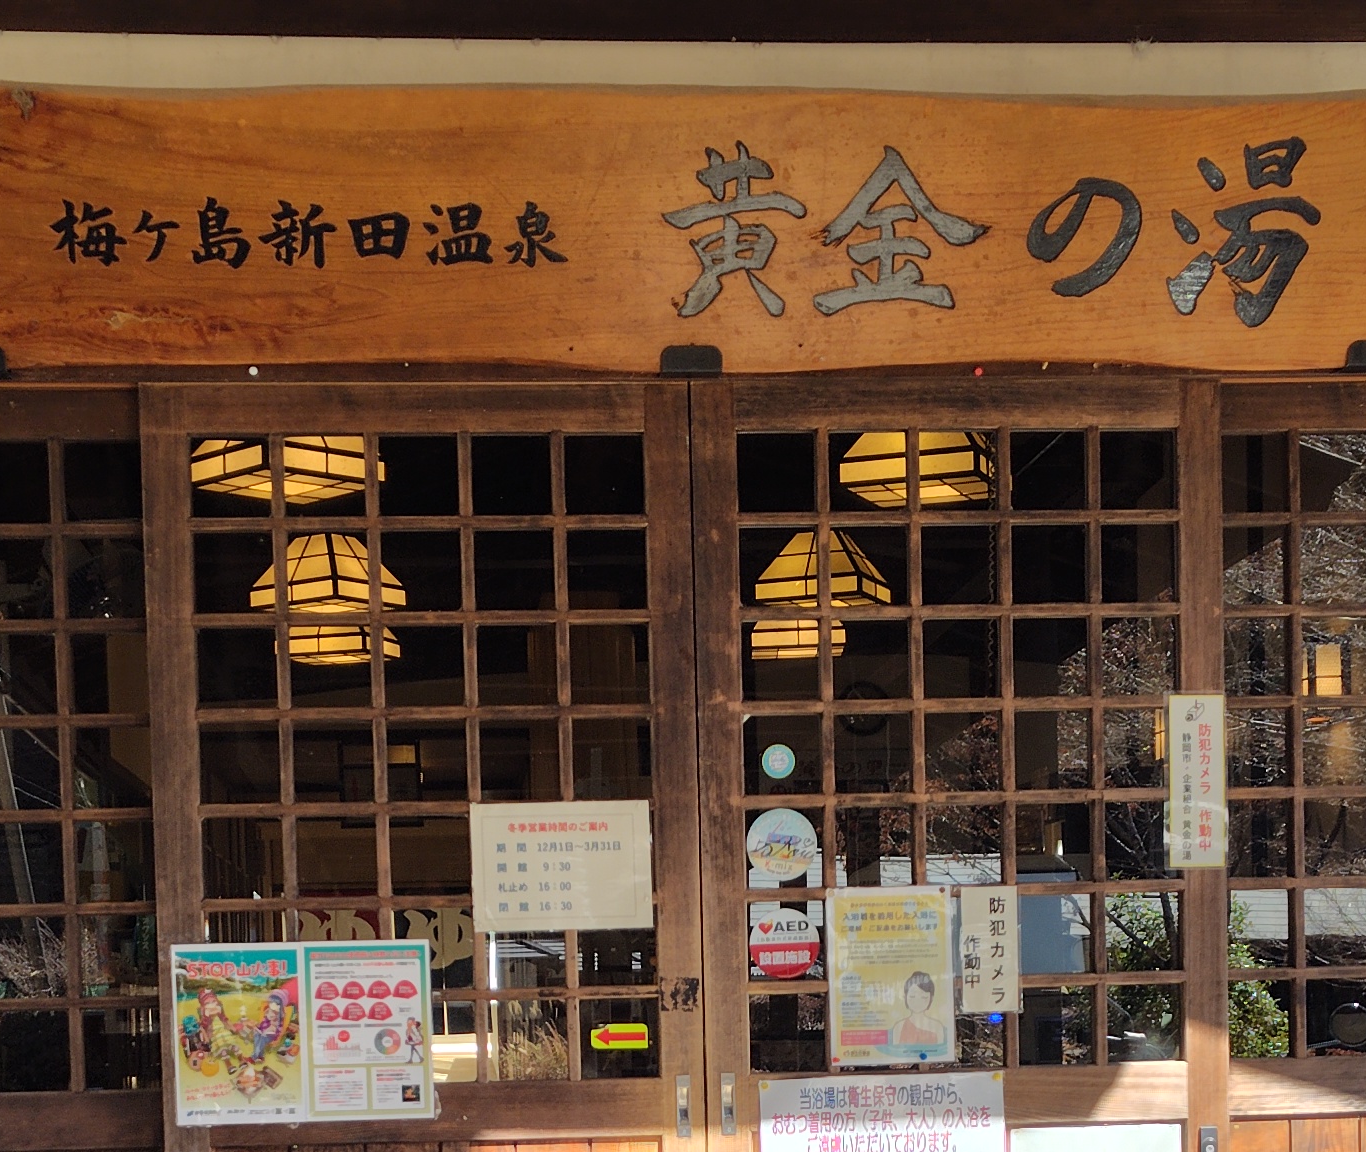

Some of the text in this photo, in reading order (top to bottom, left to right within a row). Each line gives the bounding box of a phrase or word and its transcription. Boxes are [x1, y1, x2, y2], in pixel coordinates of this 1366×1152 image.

[660, 137, 1323, 328] 黄金の湯
[1198, 723, 1212, 795] 防犯カメラ
[1199, 809, 1212, 852] 作動中
[498, 881, 529, 893] 札止め
[773, 919, 809, 933] AED
[988, 896, 1007, 1004] 防犯カメラ
[963, 934, 982, 989] 作動中
